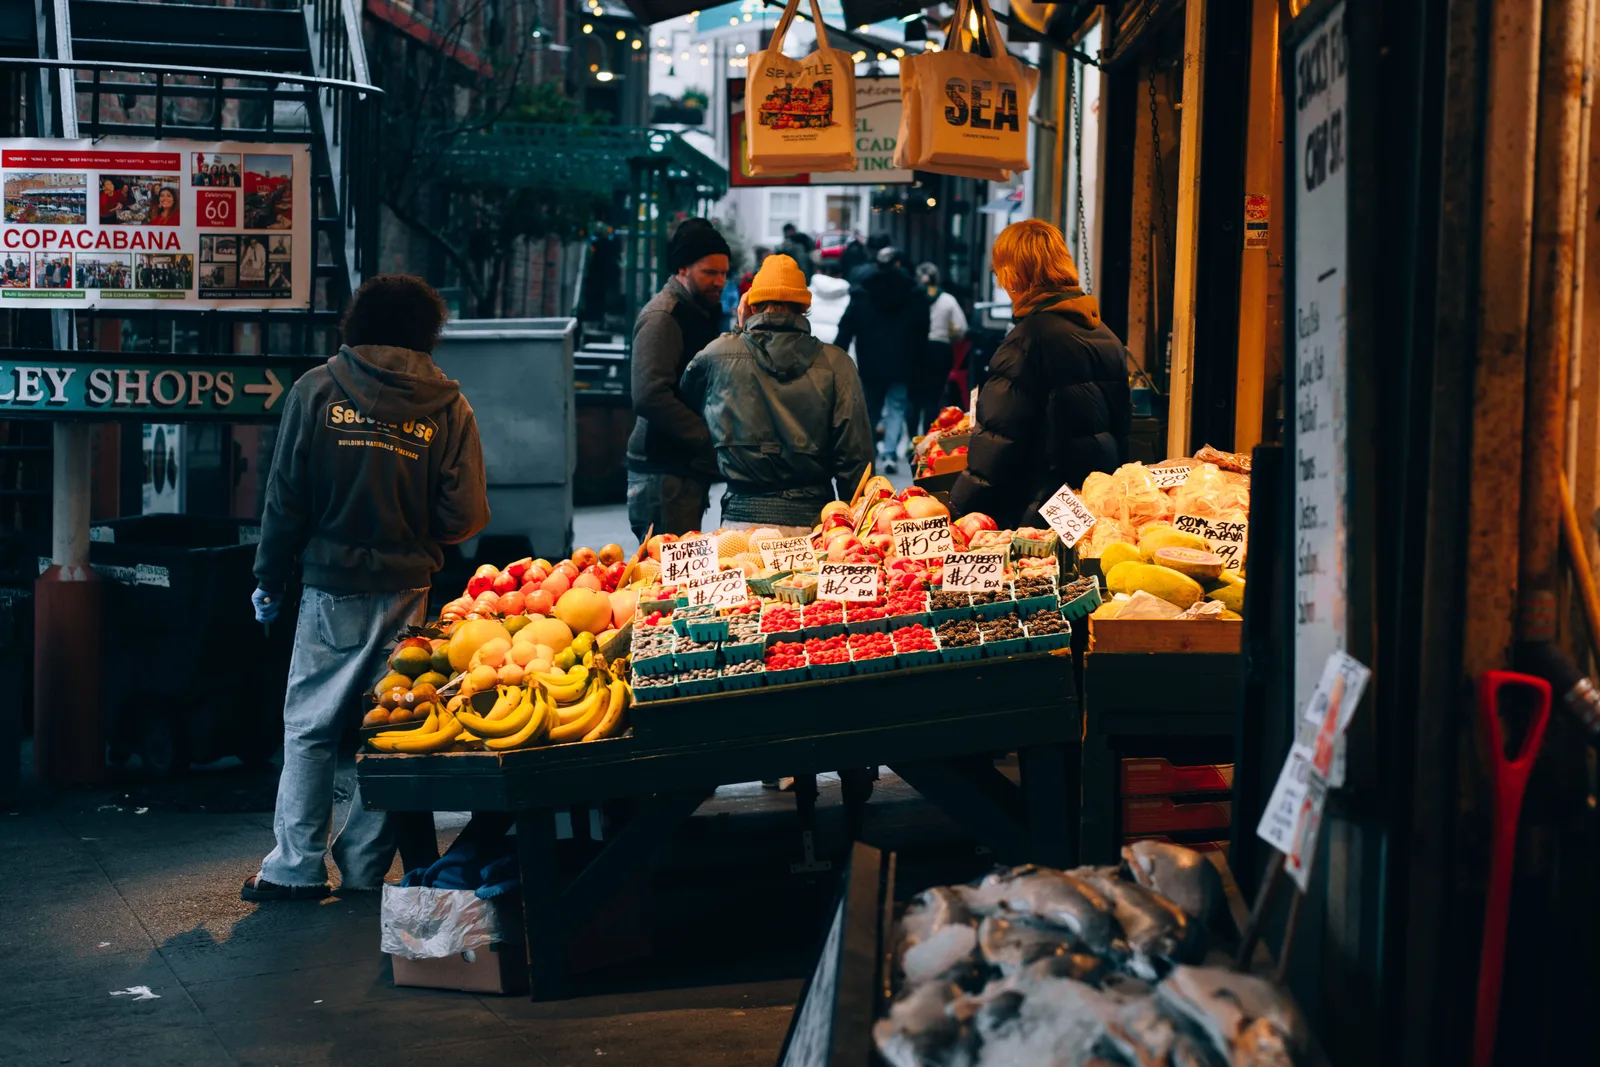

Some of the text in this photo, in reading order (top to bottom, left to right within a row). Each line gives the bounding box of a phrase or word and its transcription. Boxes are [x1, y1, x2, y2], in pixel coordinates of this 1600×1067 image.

[766, 64, 833, 78] SEATLE
[944, 77, 1019, 132] SEA
[205, 200, 229, 219] 60
[3, 229, 181, 250] COPACABANA
[89, 368, 234, 405] SHOPS
[1058, 490, 1094, 527] KUMQUATS
[894, 516, 949, 534] STRAWBERRY
[1176, 515, 1246, 532] ROYAL STAR
[662, 540, 709, 552] MIX CHERRY
[761, 538, 808, 550] GOLDENBERRY
[938, 544, 952, 552] BOX
[669, 546, 713, 561] TOMATOES
[944, 554, 1003, 564] BLACKBERRY
[821, 565, 877, 574] RASPBERRY
[689, 570, 742, 588] BLUEBERRY
[984, 580, 1000, 588] BOX
[731, 595, 746, 604] BOX
[858, 589, 873, 597] BOX
